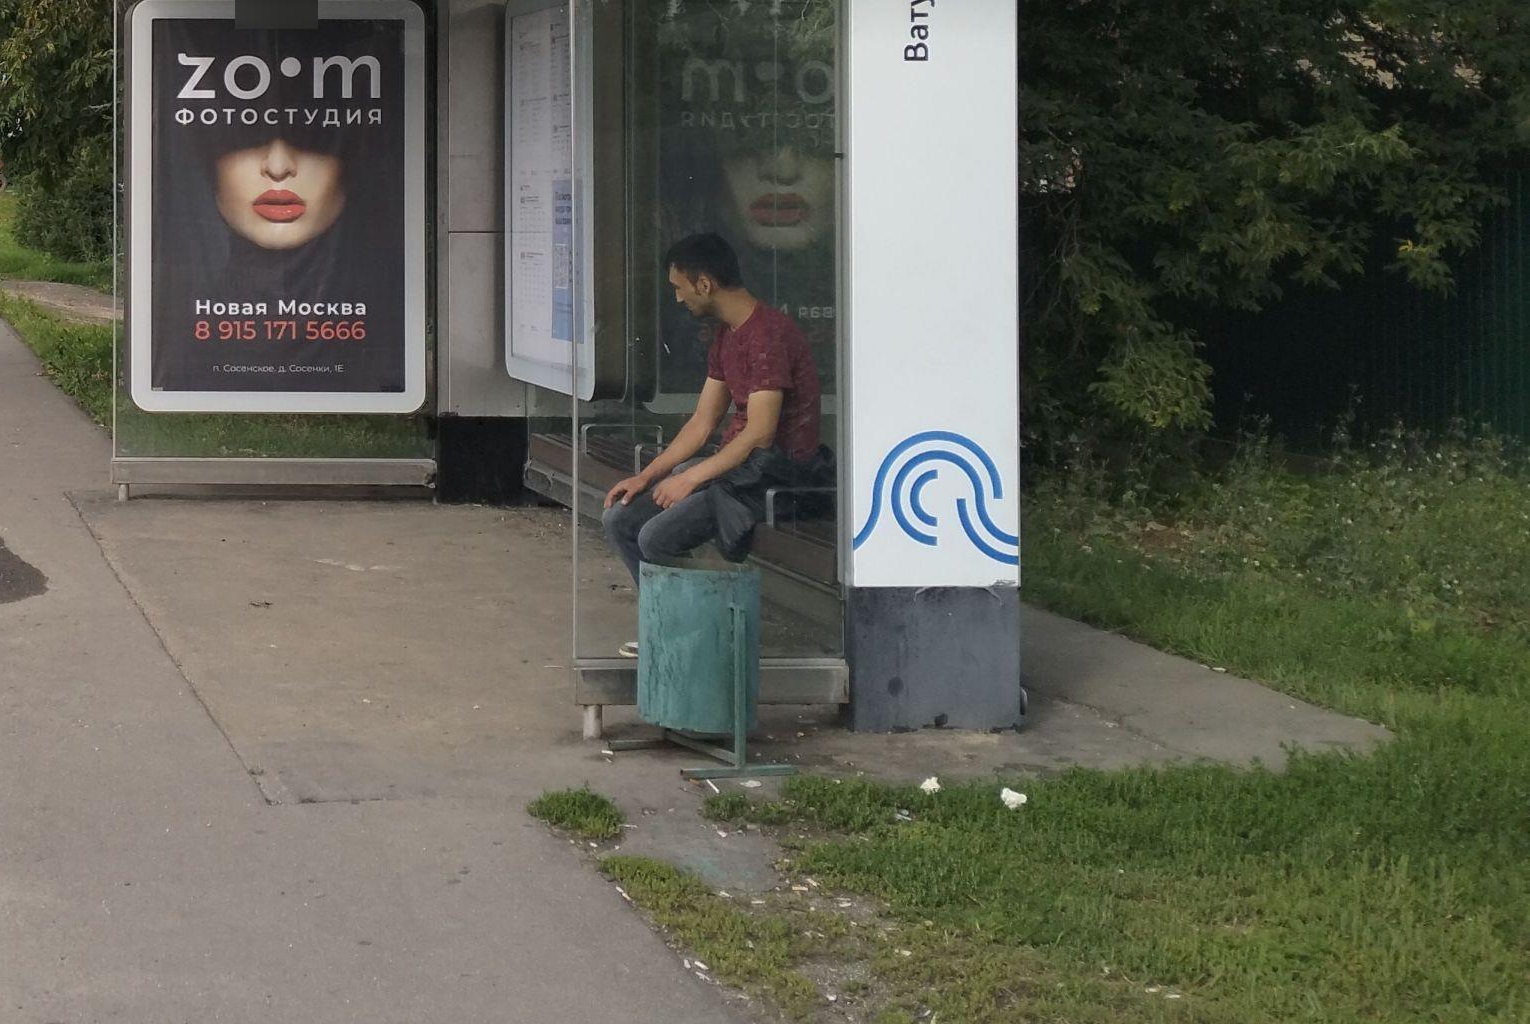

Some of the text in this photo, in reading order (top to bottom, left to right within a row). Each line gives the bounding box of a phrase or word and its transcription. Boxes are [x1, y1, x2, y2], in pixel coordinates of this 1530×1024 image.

[175, 108, 382, 128] ФОТОСТУДИЯ
[195, 299, 367, 316] Новая Москва
[195, 321, 366, 340] 8 915 171 5666
